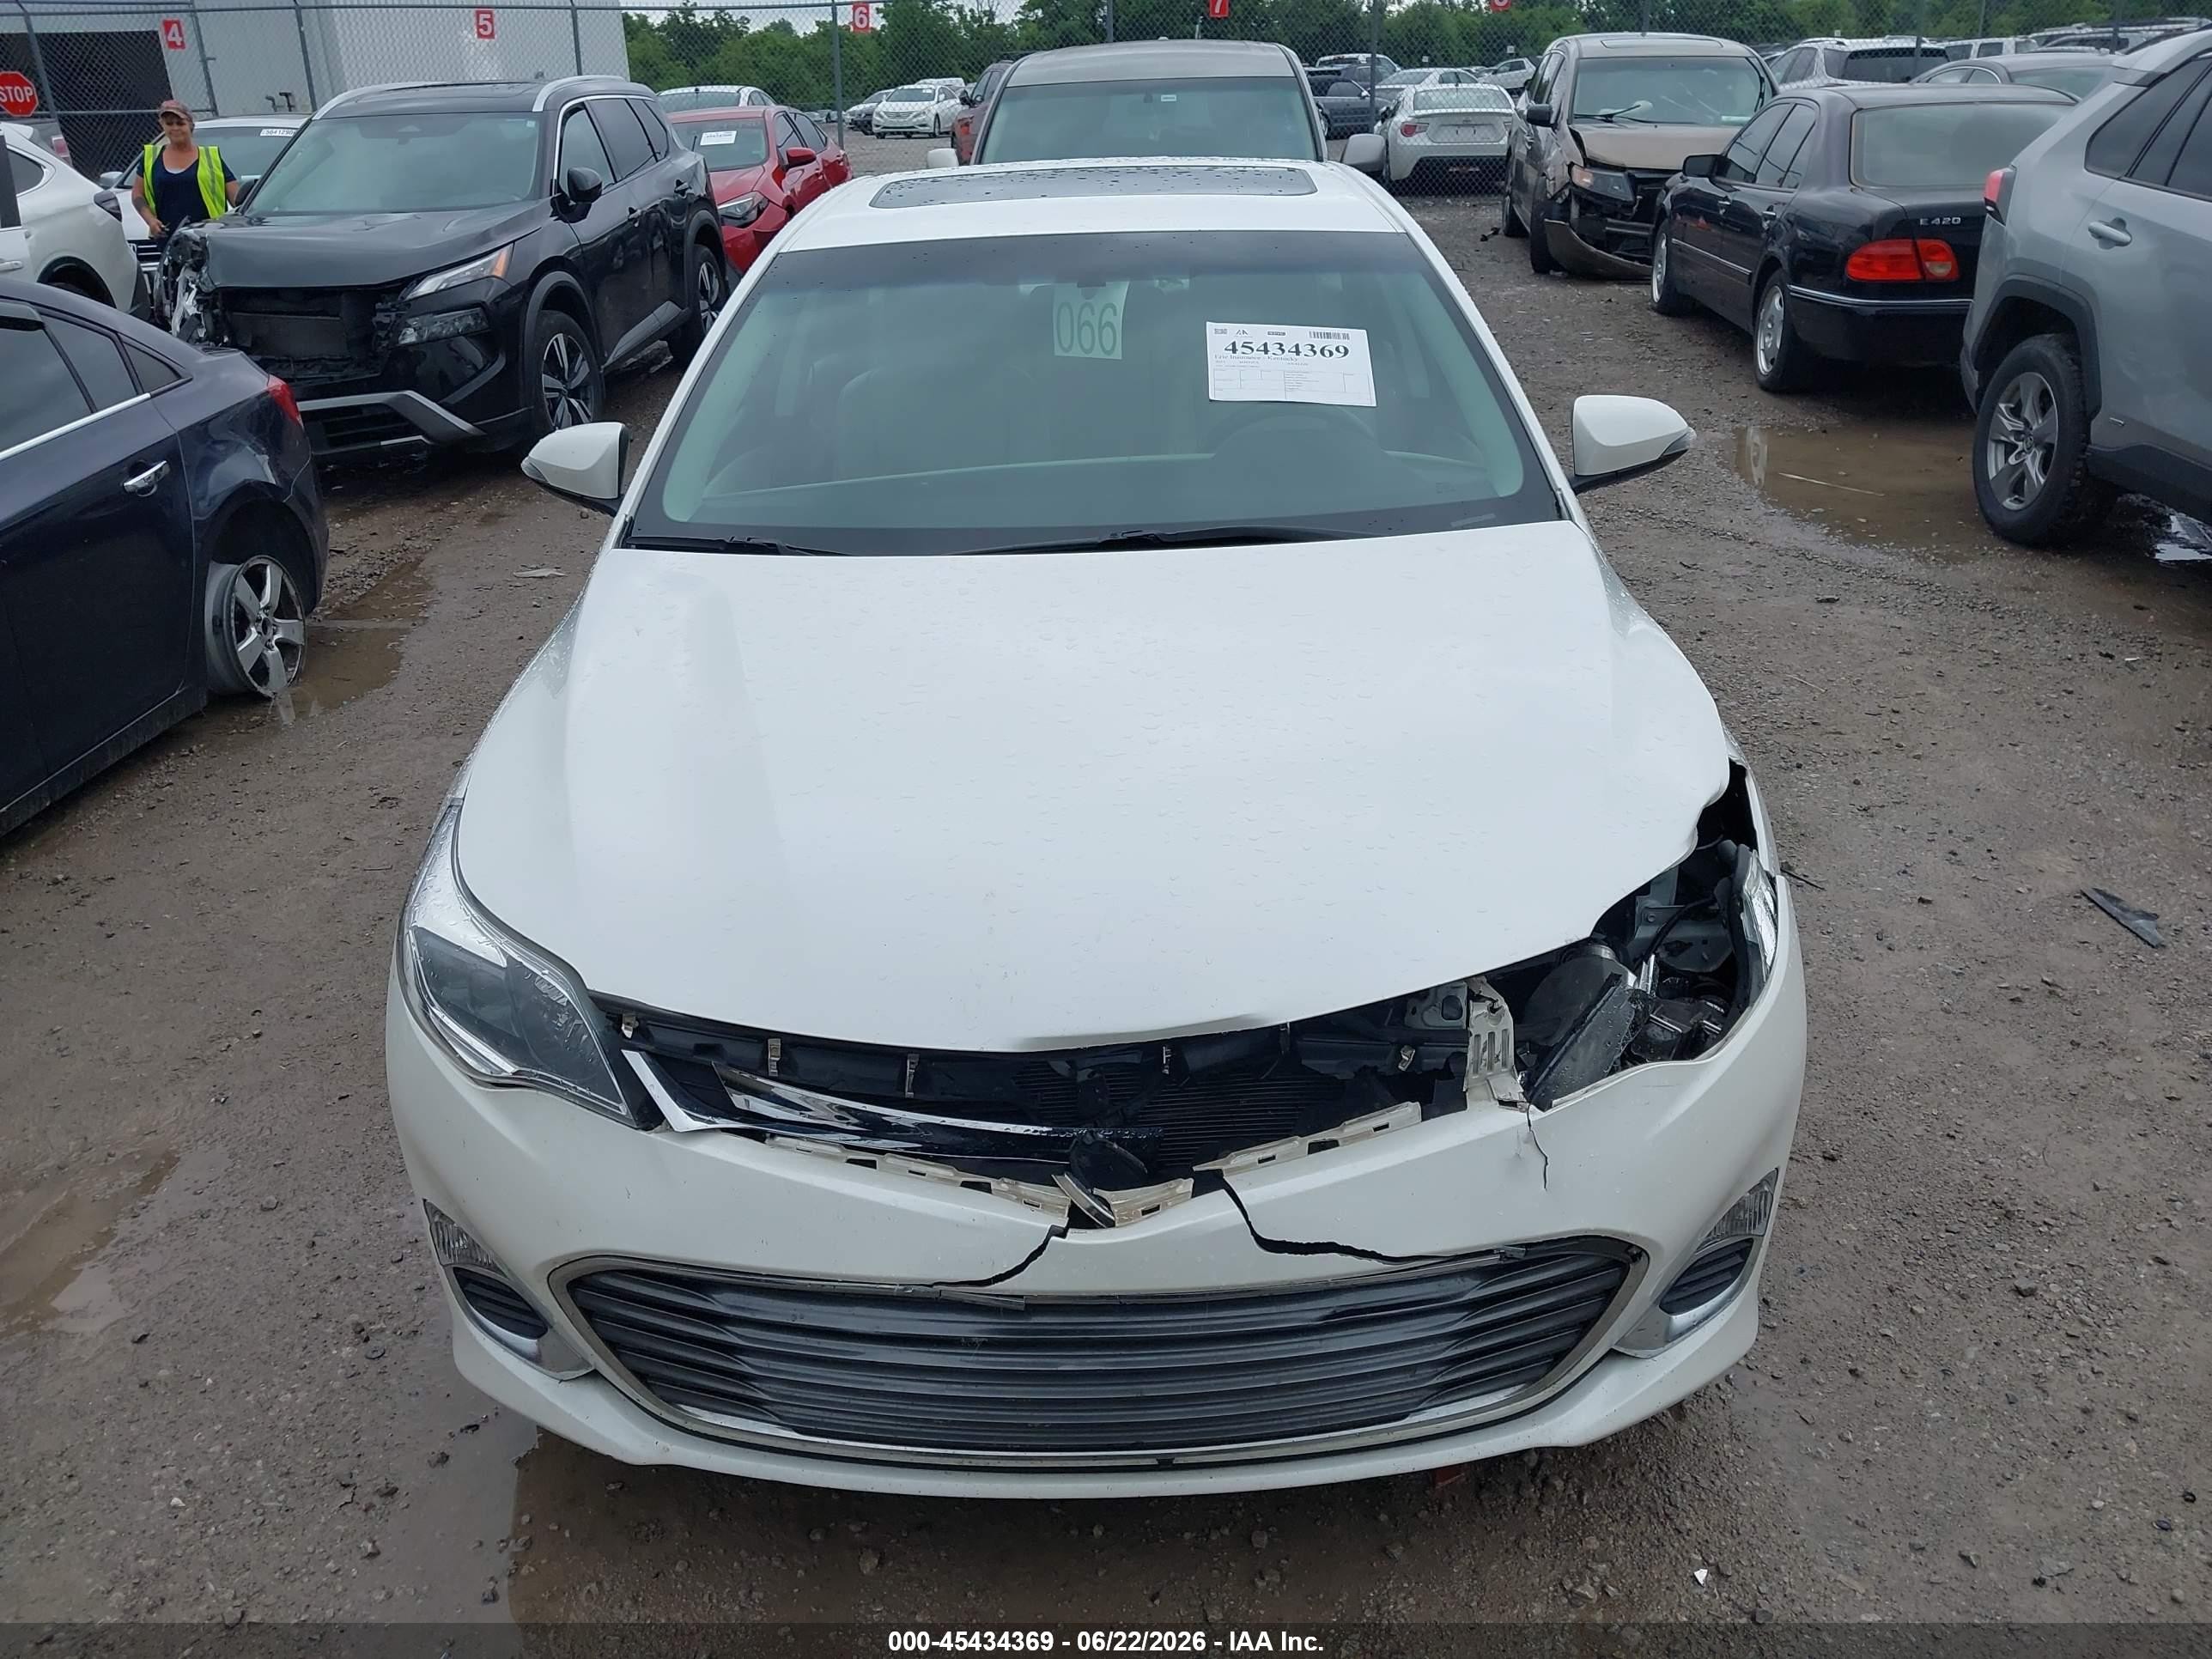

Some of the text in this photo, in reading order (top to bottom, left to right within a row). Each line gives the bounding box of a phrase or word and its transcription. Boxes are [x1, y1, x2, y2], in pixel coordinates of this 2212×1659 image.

[478, 13, 492, 36] 5
[854, 6, 868, 28] 6
[167, 23, 183, 46] 4
[0, 86, 33, 103] STOP
[1056, 301, 1117, 356] 066
[1224, 340, 1350, 359] 45434369
